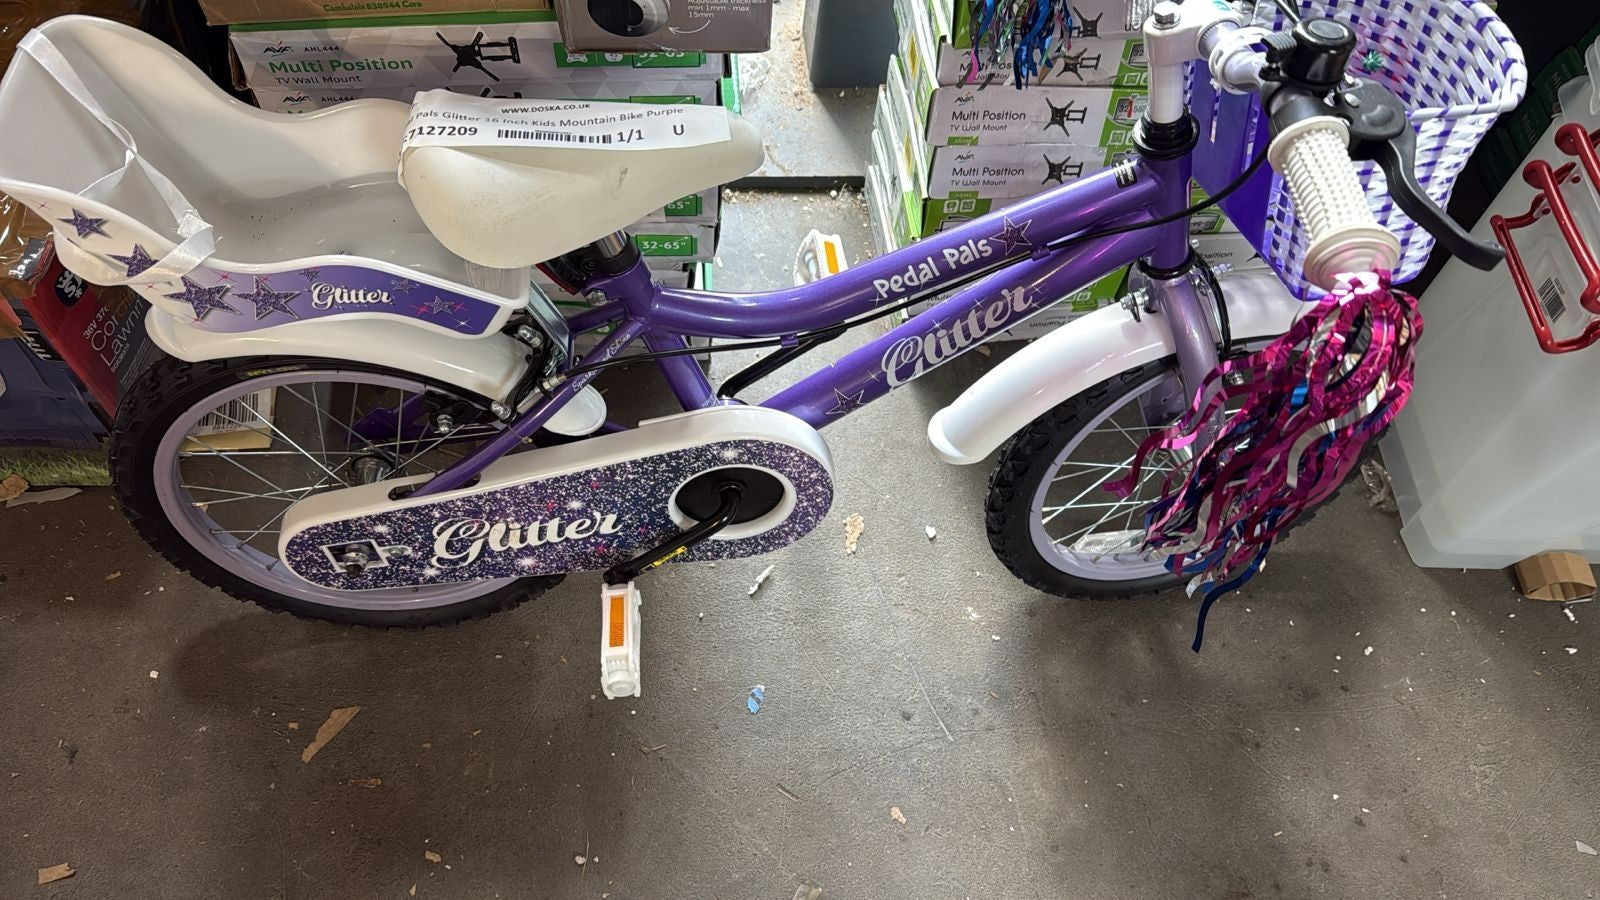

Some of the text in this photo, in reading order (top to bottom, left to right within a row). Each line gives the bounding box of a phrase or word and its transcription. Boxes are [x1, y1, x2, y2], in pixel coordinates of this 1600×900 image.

[268, 57, 414, 74] Multi Position
[274, 74, 362, 85] TV Wall Mount
[415, 105, 685, 128] Pals Glitter 16 Inch Kids Mountain Bike Purple
[500, 103, 592, 115] WWW.DOSKA.CO.UK
[951, 109, 1027, 121] Multi Position
[616, 128, 645, 144] 1/1
[672, 123, 685, 136] U
[949, 124, 1008, 132] TV Wall Mount
[951, 166, 1025, 177] Multi Position
[950, 179, 1007, 187] TV Wall Mount
[872, 238, 993, 299] Pedal Pals
[310, 281, 392, 311] Glitter
[83, 321, 98, 340] 36V
[881, 285, 1034, 390] Glitter
[431, 510, 623, 568] Glitter
